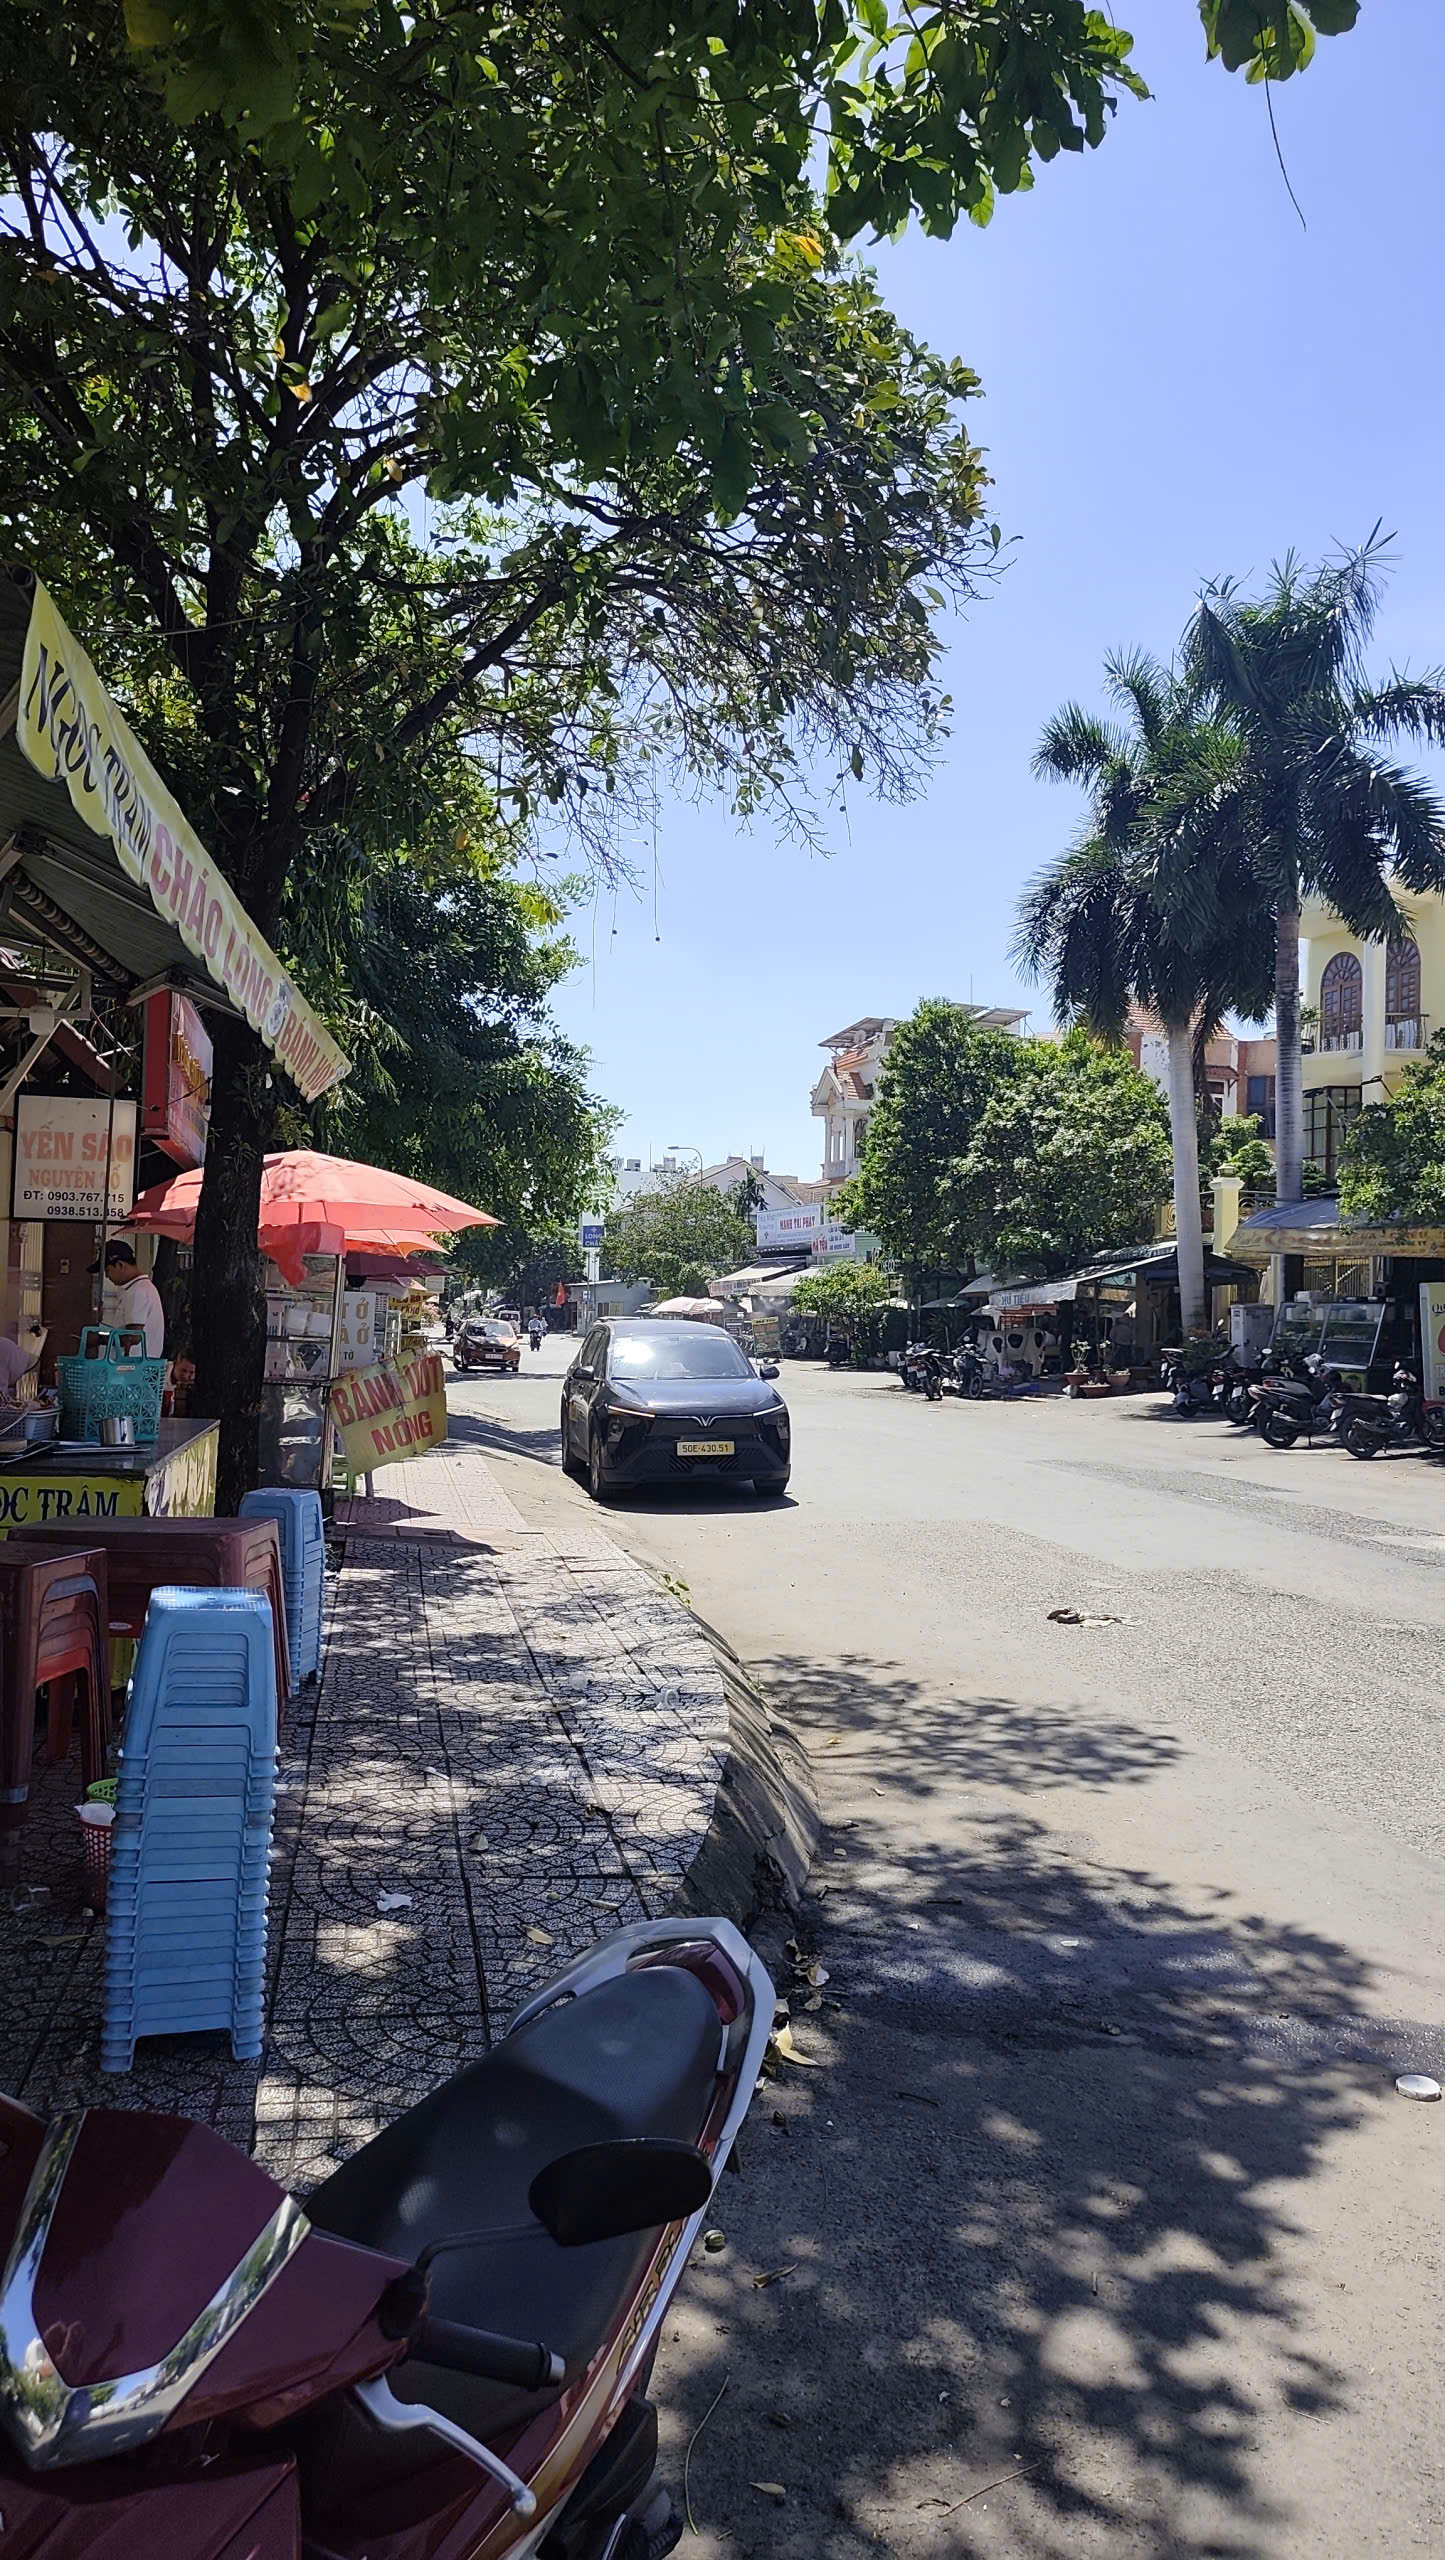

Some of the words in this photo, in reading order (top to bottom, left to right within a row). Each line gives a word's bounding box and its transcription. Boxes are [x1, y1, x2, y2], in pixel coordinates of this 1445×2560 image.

[150, 824, 223, 957] CHÁO
[223, 927, 274, 1022] LÒNG
[279, 1010, 321, 1076] BÁNH
[21, 1121, 74, 1161] YẾN
[82, 1128, 133, 1163] SÀO
[23, 1191, 44, 1201] ĐT:
[29, 1166, 96, 1189] NGUYÊN
[332, 1373, 405, 1427] BÁNH
[371, 1411, 433, 1456] NÓNG
[682, 1444, 729, 1453] 50E-430.51
[37, 1485, 120, 1521] TRÂM
